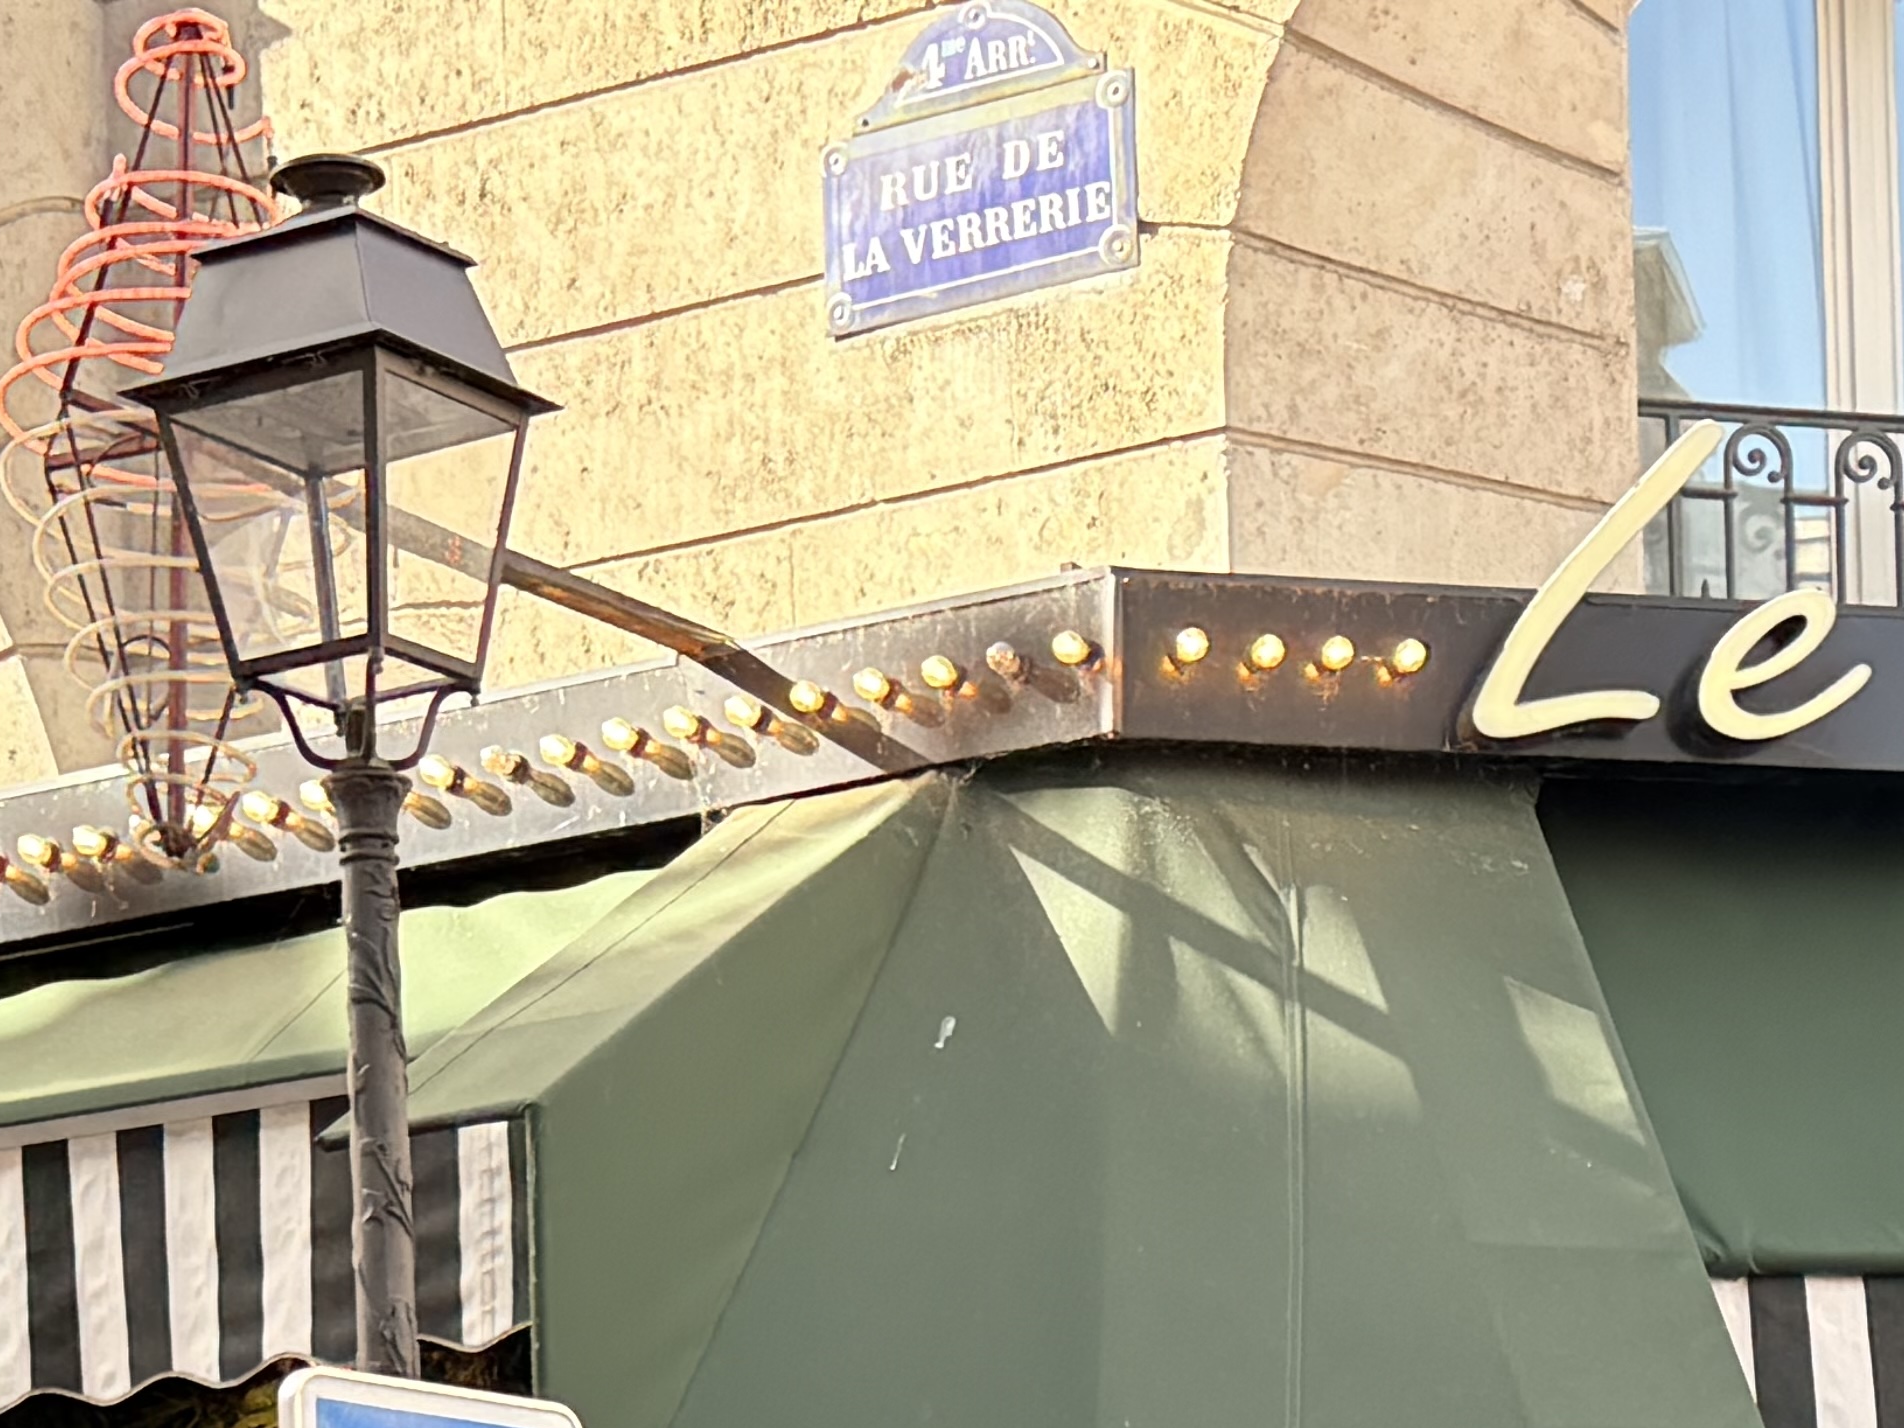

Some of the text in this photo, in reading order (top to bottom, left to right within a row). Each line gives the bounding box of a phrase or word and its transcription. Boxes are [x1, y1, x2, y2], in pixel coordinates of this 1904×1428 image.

[880, 130, 1064, 211] RUE DE
[842, 181, 1112, 281] LA VERRERIE
[1472, 420, 1872, 742] Le
